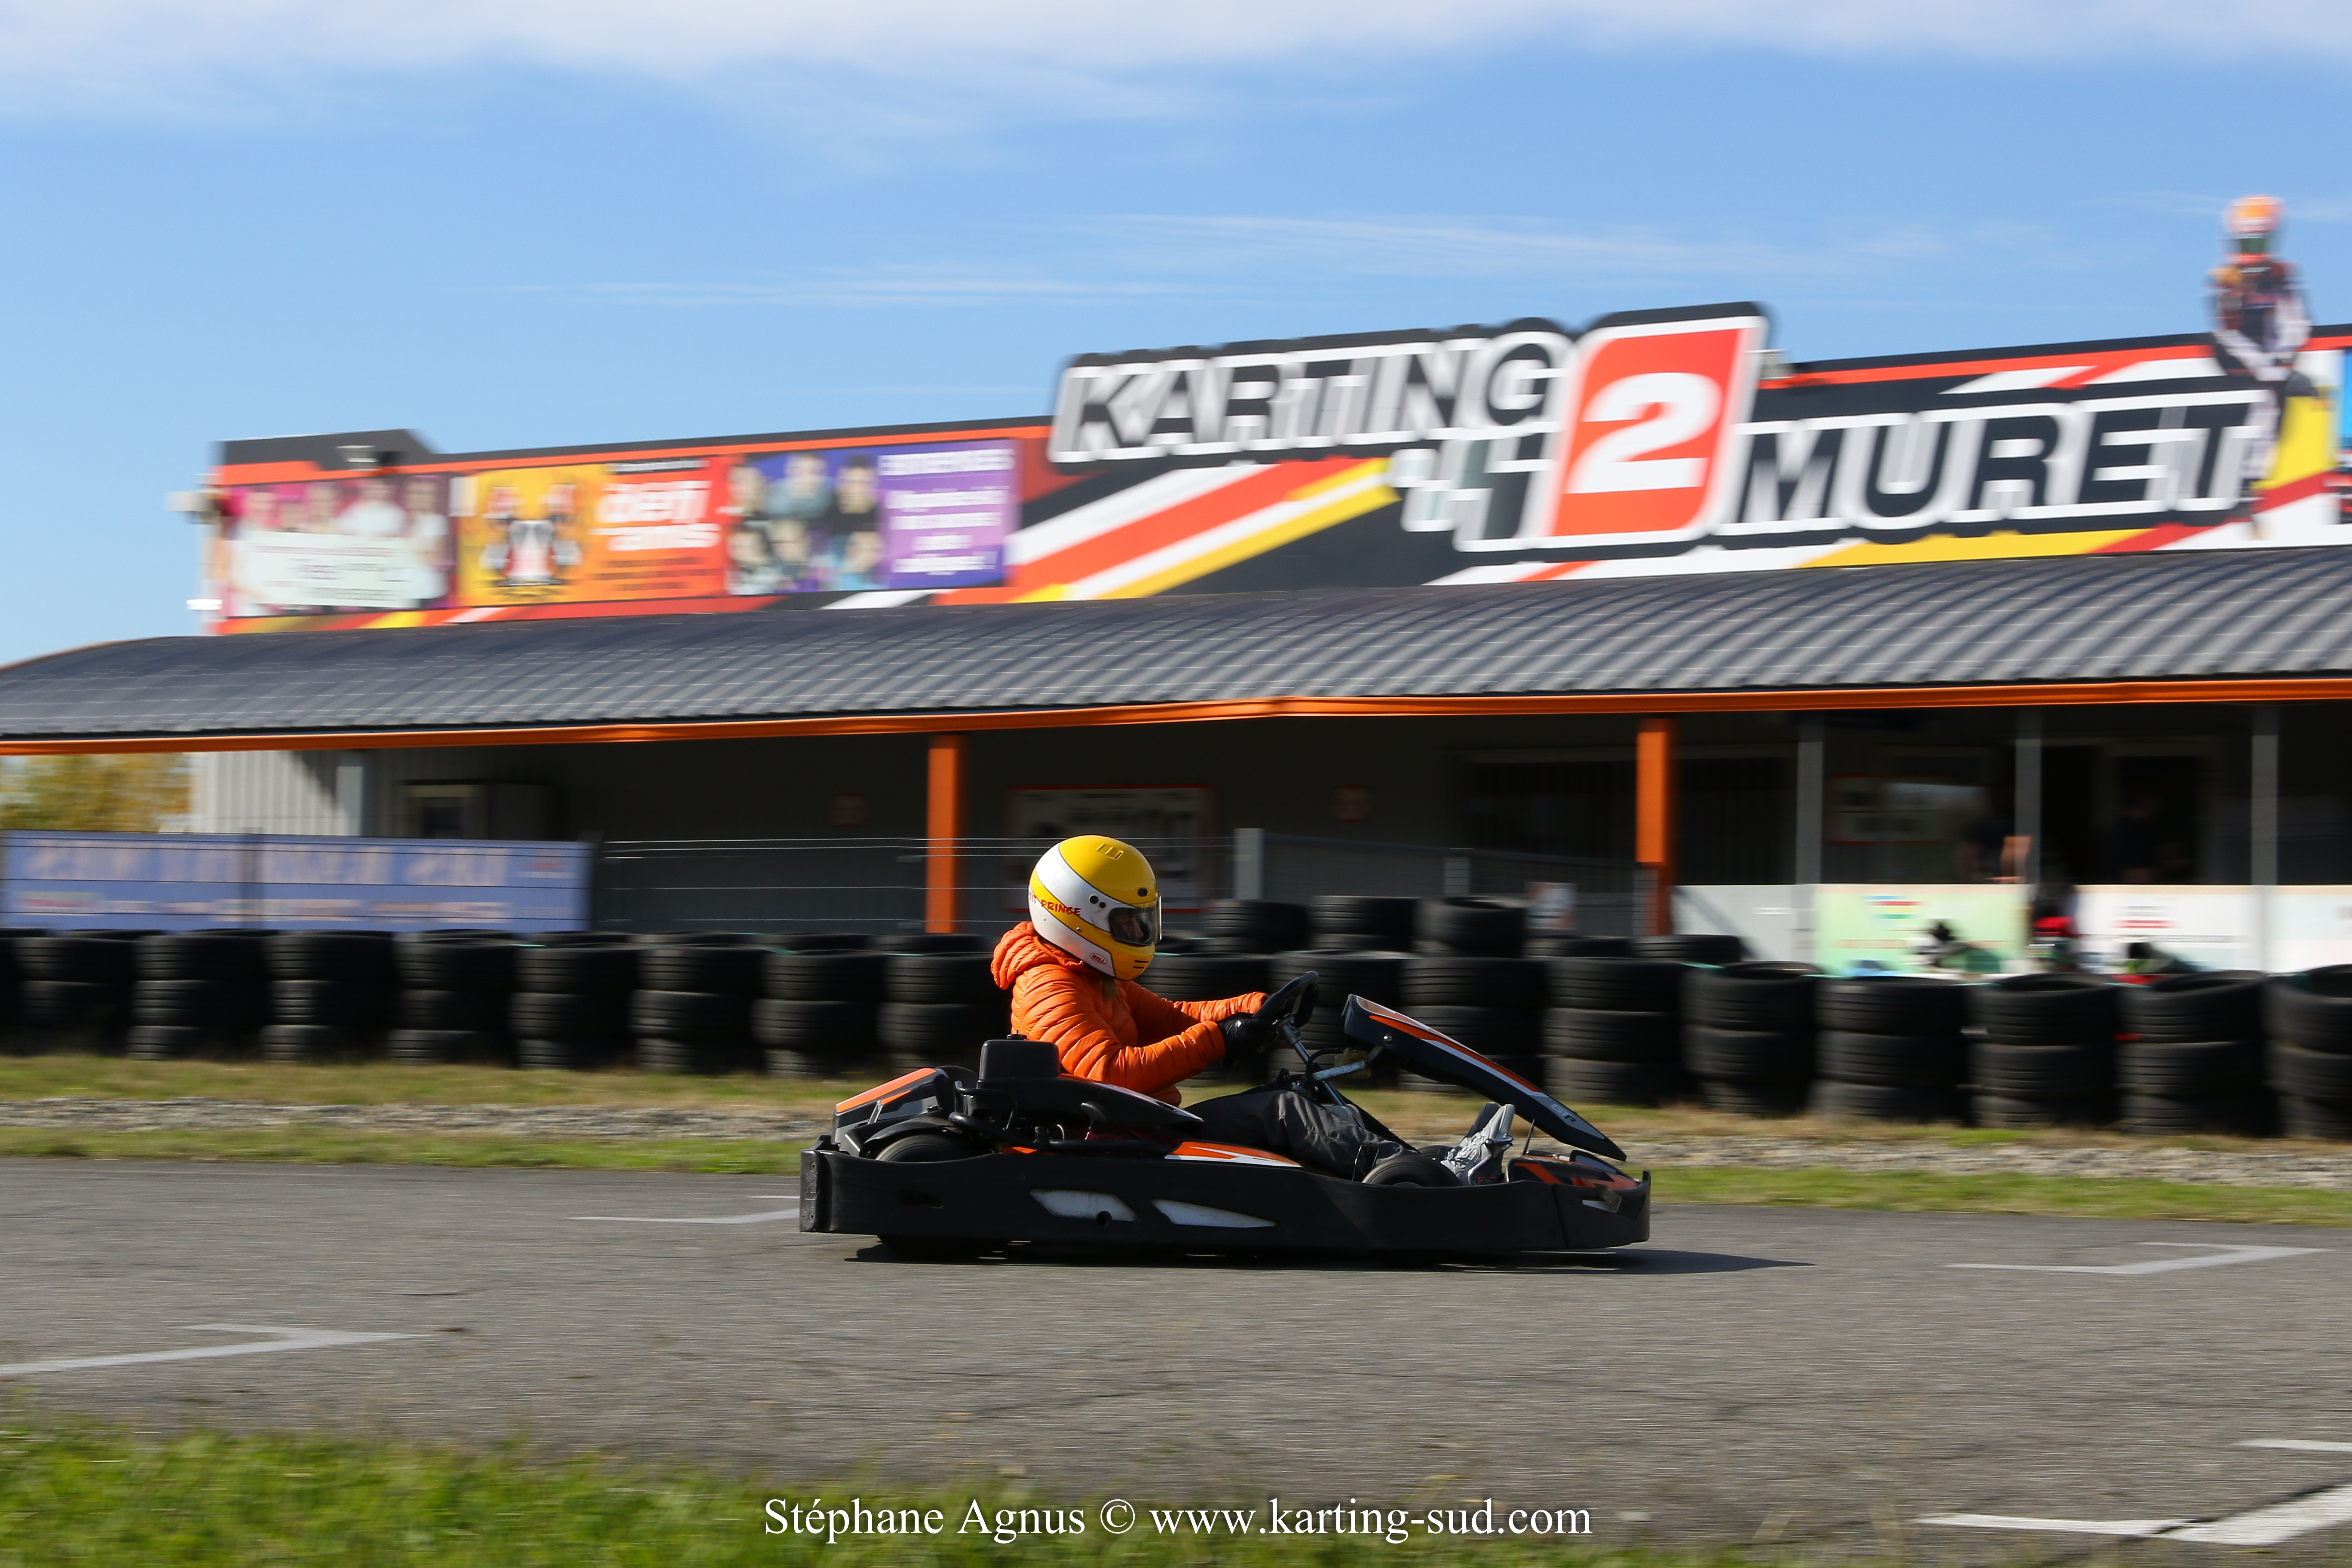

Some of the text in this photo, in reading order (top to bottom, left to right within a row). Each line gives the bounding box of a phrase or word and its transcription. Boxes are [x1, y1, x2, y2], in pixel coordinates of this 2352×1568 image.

[1053, 332, 2267, 529] KARTING 2 MURET
[1028, 891, 1081, 916] TIT PRINCE
[1092, 954, 1105, 963] BELL
